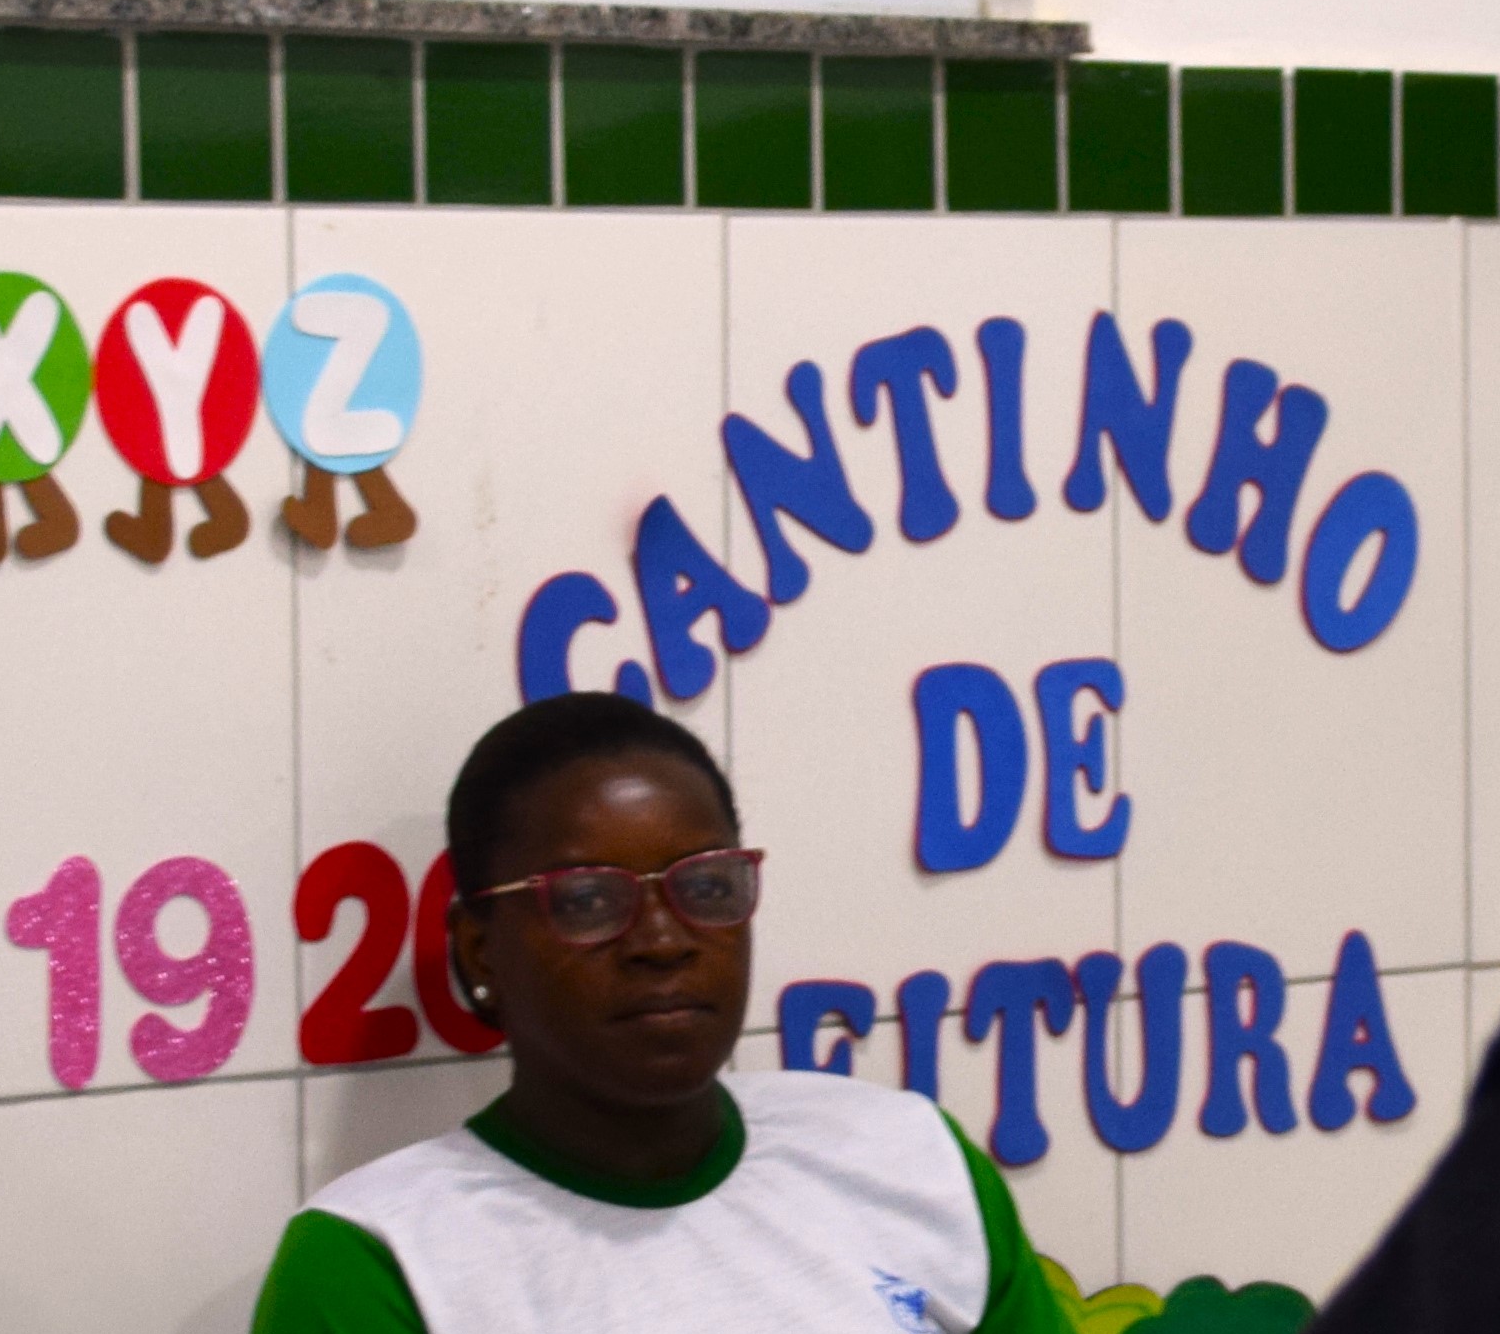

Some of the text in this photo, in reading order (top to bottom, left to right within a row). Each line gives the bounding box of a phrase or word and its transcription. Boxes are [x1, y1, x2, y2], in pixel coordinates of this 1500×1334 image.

[517, 310, 1418, 713] CANTINHO
[913, 656, 1131, 873] DE
[5, 855, 256, 1091] 19
